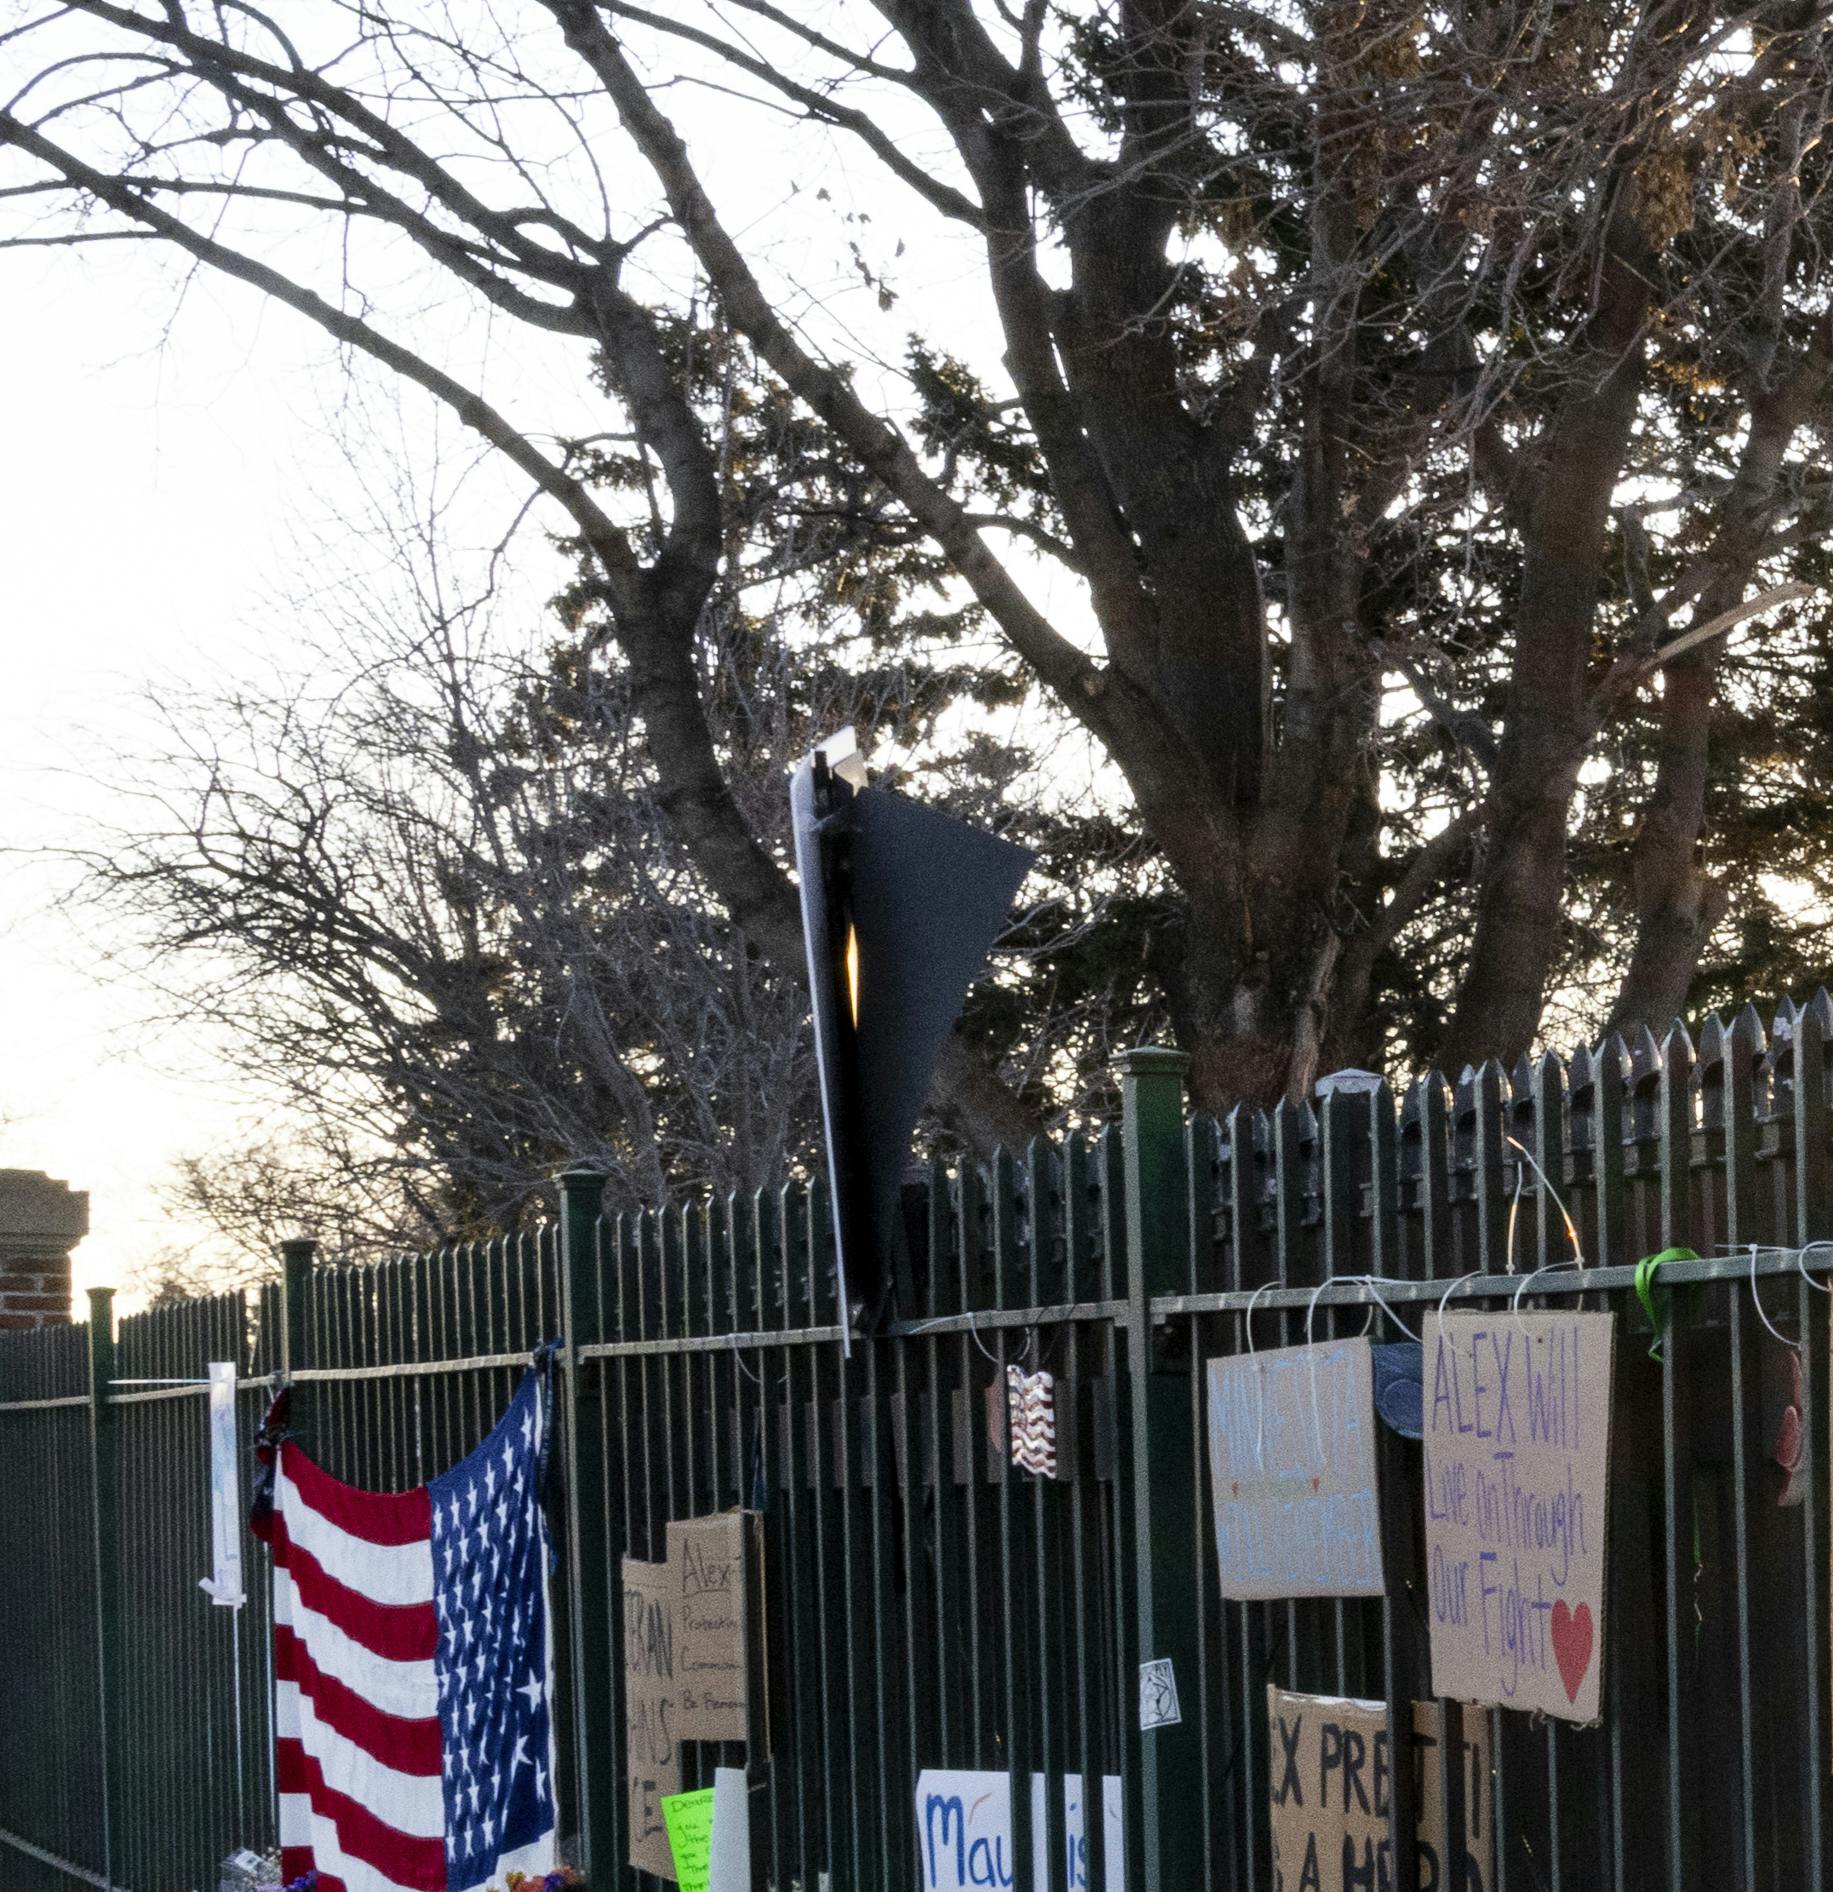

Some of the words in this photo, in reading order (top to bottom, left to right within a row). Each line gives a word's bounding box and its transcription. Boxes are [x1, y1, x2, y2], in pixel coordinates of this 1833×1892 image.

[1433, 1331, 1516, 1443] ALEX
[682, 1537, 730, 1593] Alex
[1435, 1544, 1469, 1626] Our
[1479, 1552, 1552, 1696] Fight
